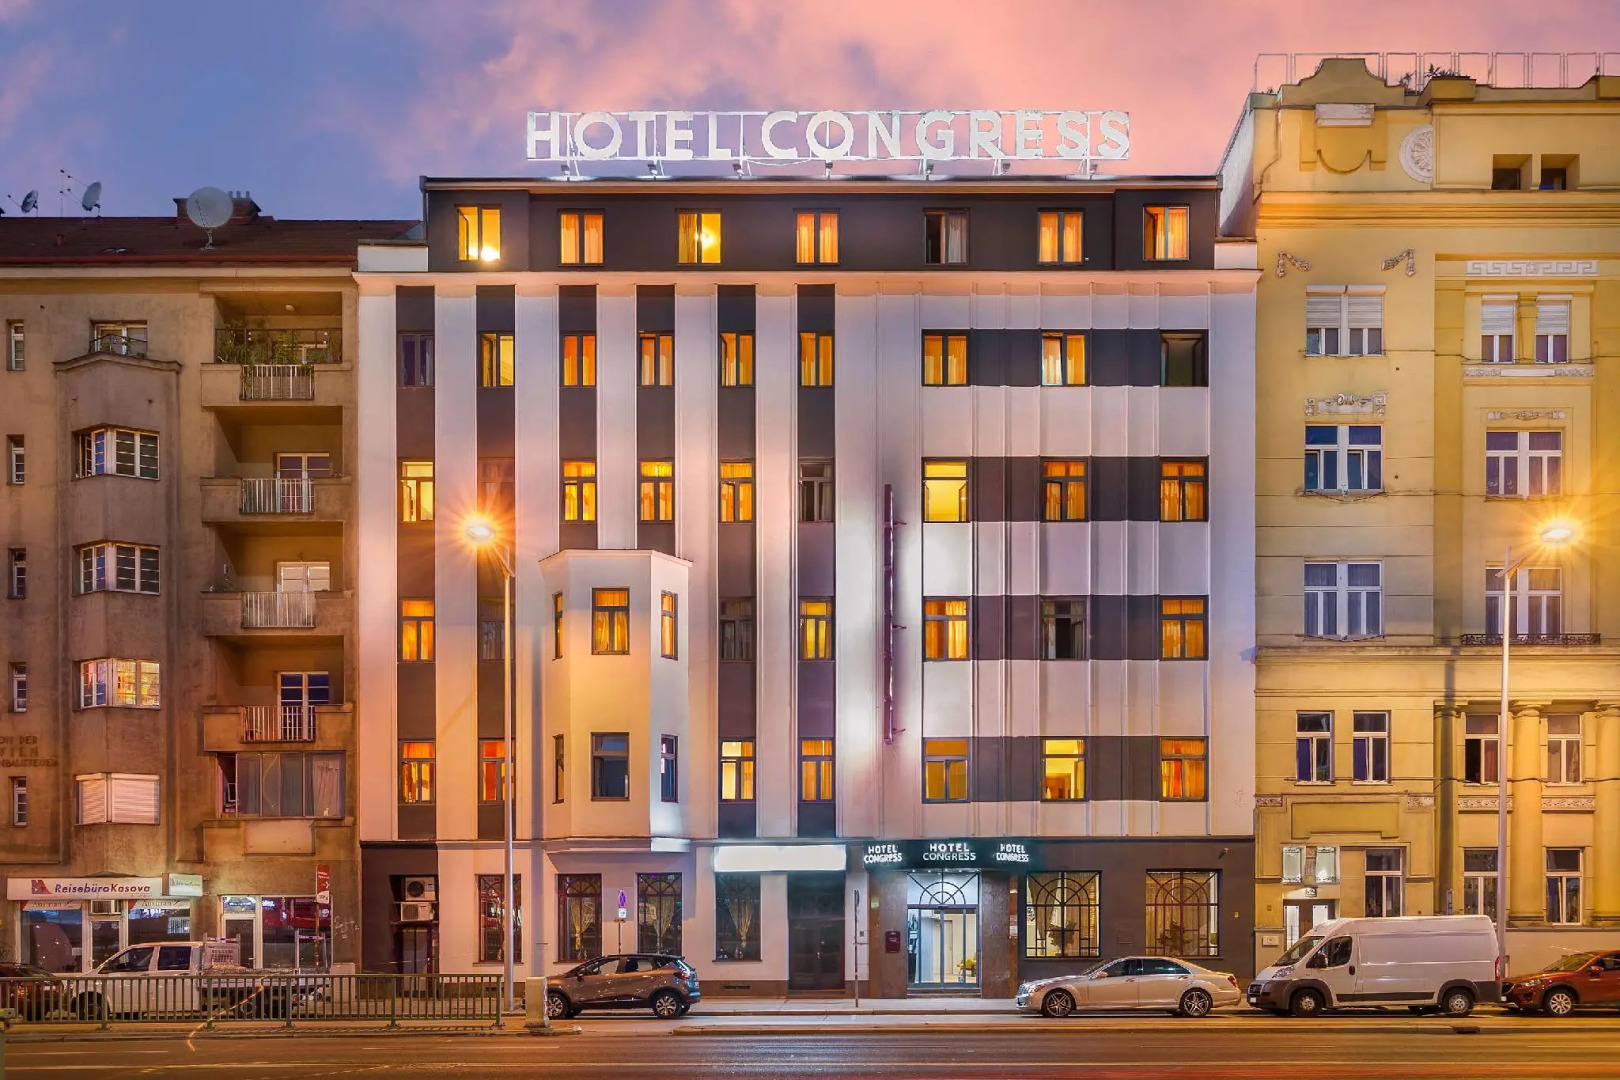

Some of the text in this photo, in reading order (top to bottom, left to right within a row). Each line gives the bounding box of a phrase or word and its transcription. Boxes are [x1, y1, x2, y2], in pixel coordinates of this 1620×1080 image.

[527, 110, 1130, 160] HOTEL CONGRESS
[868, 845, 898, 854] HOTEL
[929, 843, 970, 852] HOTEL
[1000, 843, 1026, 854] HOTEL
[863, 853, 902, 864] CONGRESS
[922, 852, 977, 861] CONGRESS
[995, 853, 1030, 863] CONGRESS
